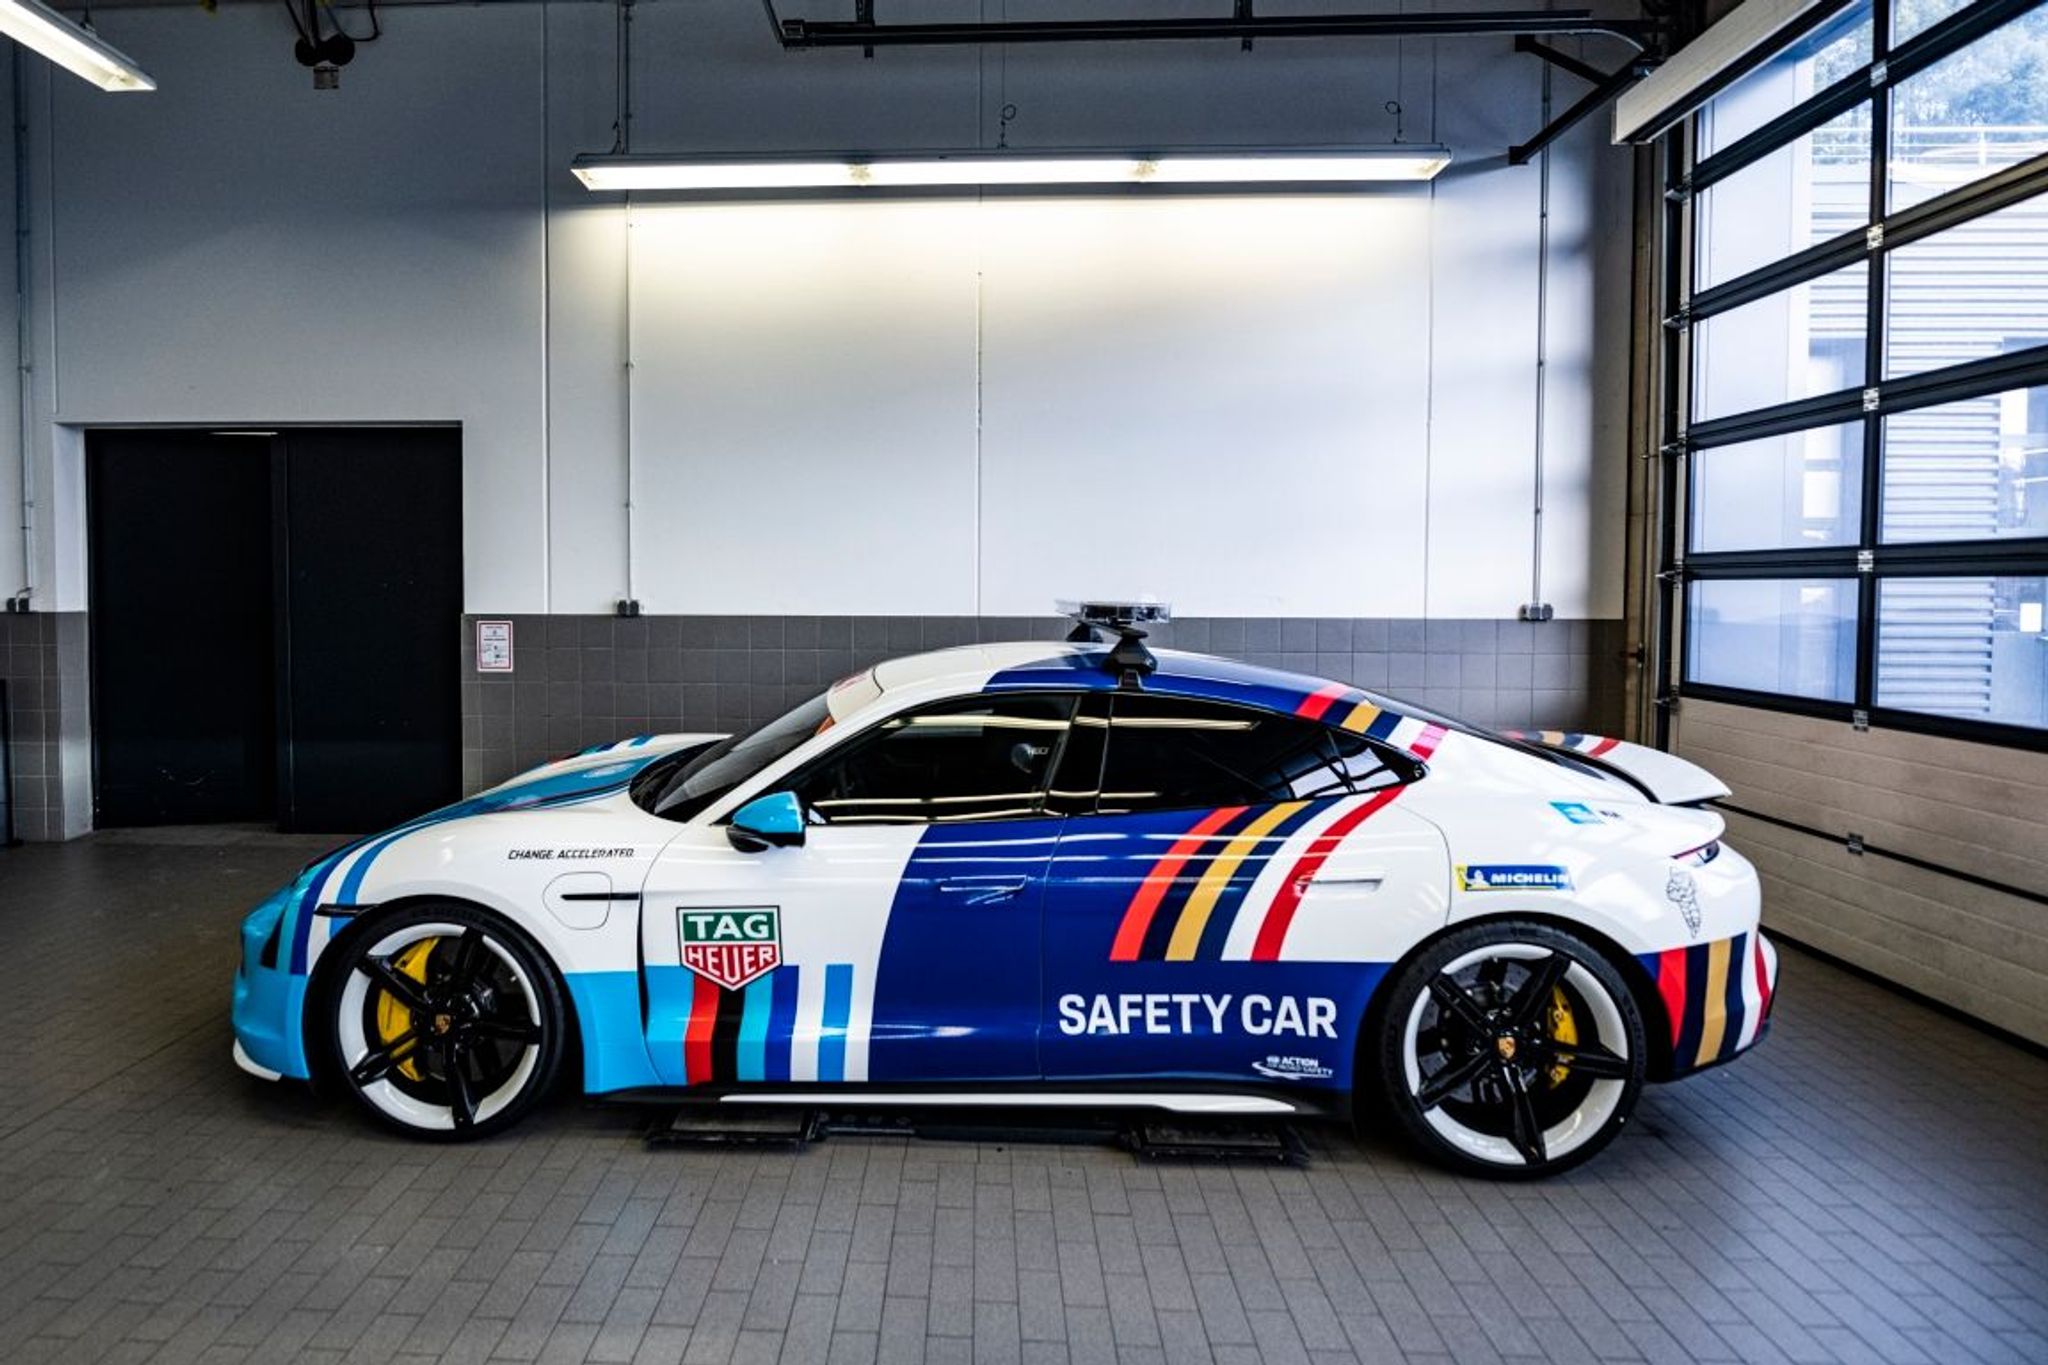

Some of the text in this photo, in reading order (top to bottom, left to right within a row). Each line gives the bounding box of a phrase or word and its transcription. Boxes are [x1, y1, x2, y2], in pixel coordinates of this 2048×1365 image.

[1491, 873, 1568, 884] MICHELIN
[687, 914, 769, 939] TAG
[687, 947, 774, 984] HEUER
[1058, 994, 1338, 1039] SAFETY CAR
[1281, 1055, 1319, 1068] ACTION
